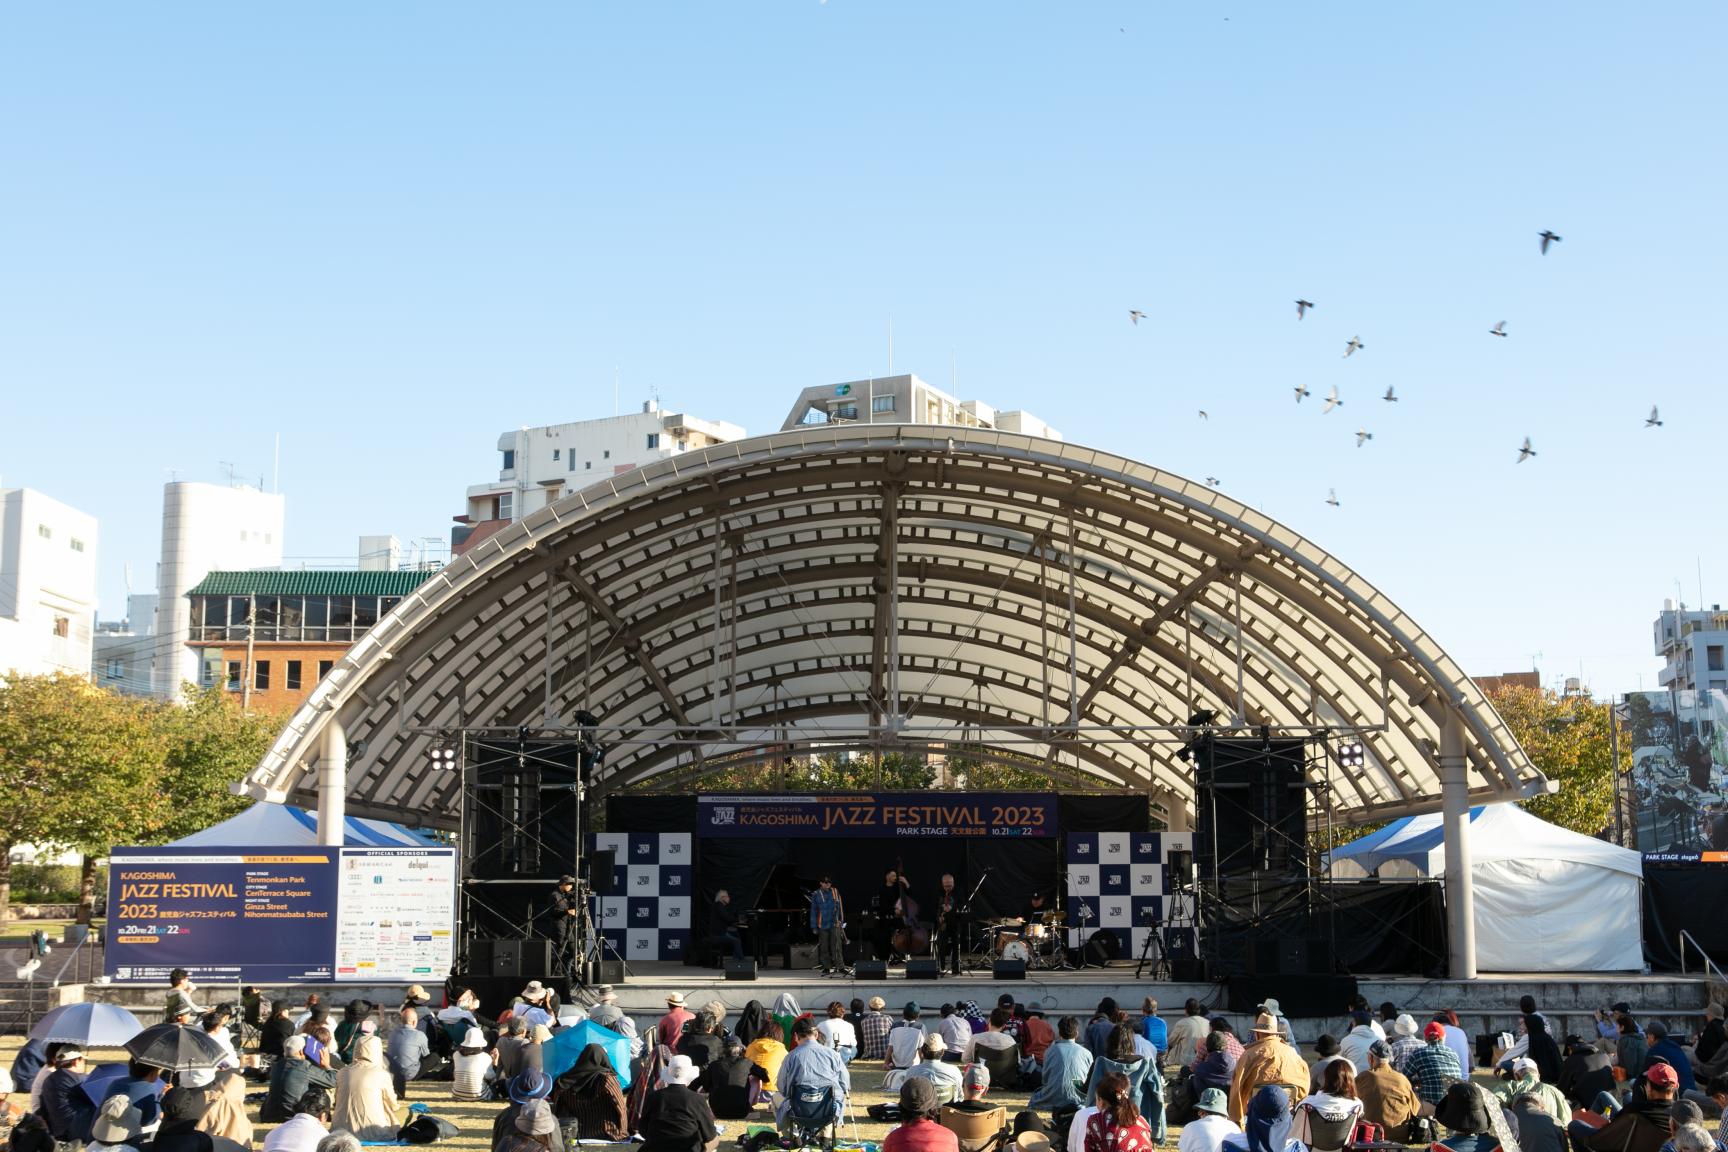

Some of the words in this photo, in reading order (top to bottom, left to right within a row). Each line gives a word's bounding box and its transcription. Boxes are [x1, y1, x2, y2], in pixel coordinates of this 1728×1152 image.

[739, 814, 819, 825] KAGOSHIMA
[822, 807, 876, 831] JAZZ
[882, 806, 986, 825] FESTIVAL
[991, 806, 1045, 825] 2023
[896, 827, 919, 835] PARK
[920, 827, 948, 836] STAGE
[120, 872, 176, 880] KAGOSHIMA
[119, 883, 159, 901] JAZZ
[163, 883, 238, 898] FESTIVAL
[286, 890, 311, 898] Square
[118, 904, 158, 918] 2023
